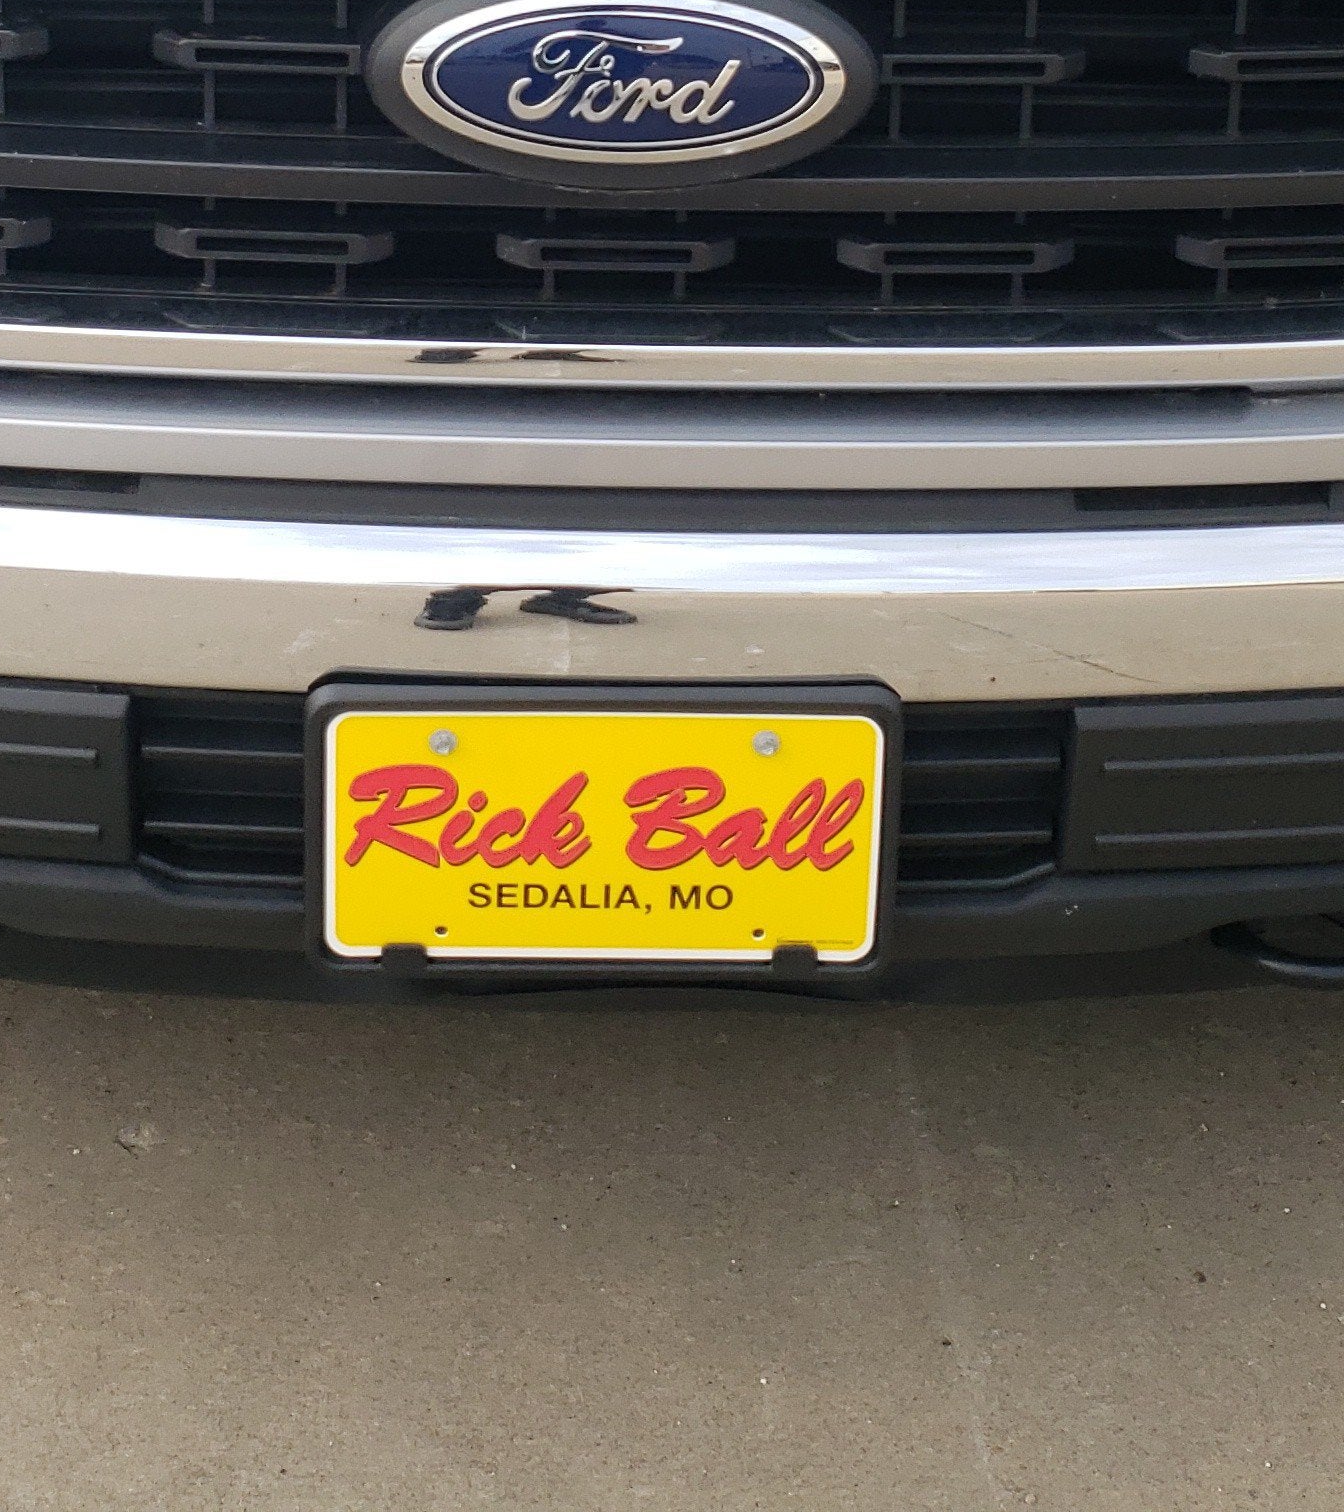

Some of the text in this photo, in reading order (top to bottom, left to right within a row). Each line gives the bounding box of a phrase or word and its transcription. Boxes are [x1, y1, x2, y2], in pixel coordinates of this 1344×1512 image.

[508, 29, 741, 124] Ford
[344, 764, 865, 871] Rick Ball
[467, 882, 734, 915] SEDALIA, MO
